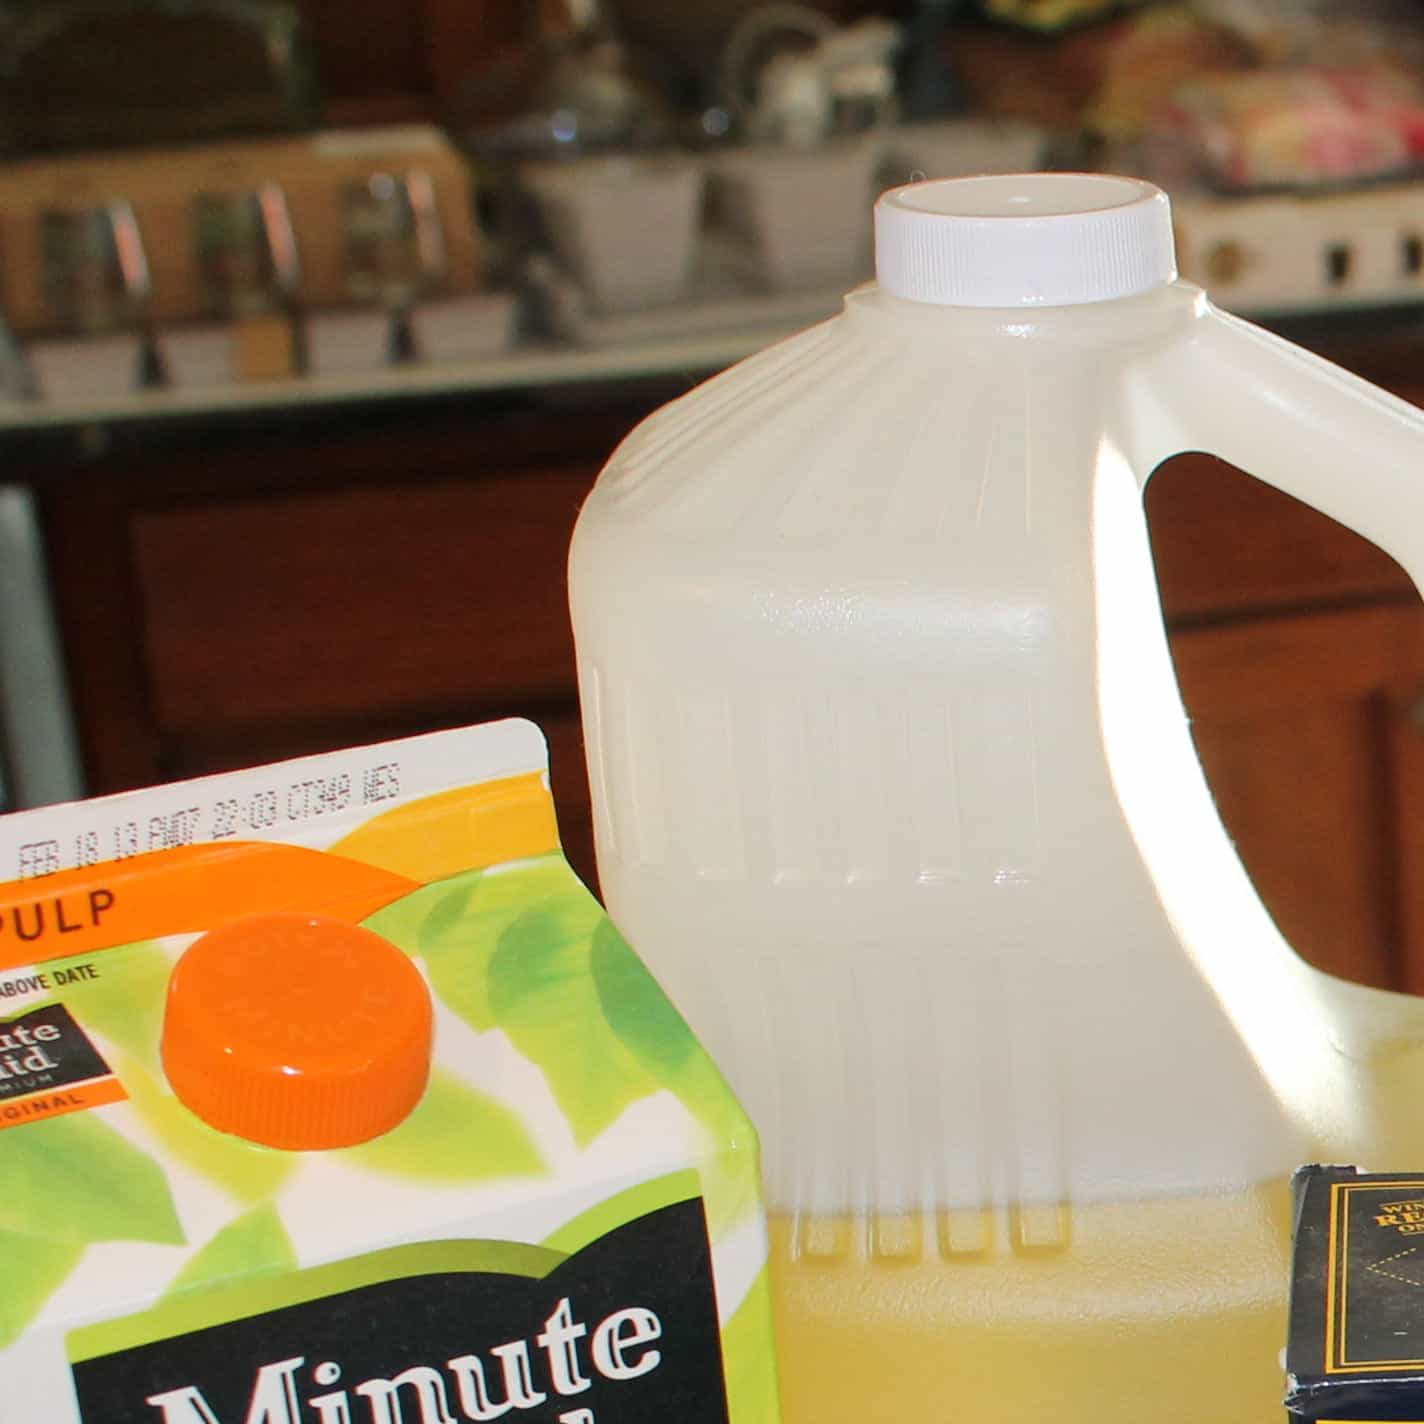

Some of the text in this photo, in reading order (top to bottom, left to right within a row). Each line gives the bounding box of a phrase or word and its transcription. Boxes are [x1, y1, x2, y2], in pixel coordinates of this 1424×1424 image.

[0, 889, 115, 942] ULP
[53, 964, 100, 985] DATE
[0, 1094, 82, 1121] GINAL
[1397, 1221, 1420, 1234] ON
